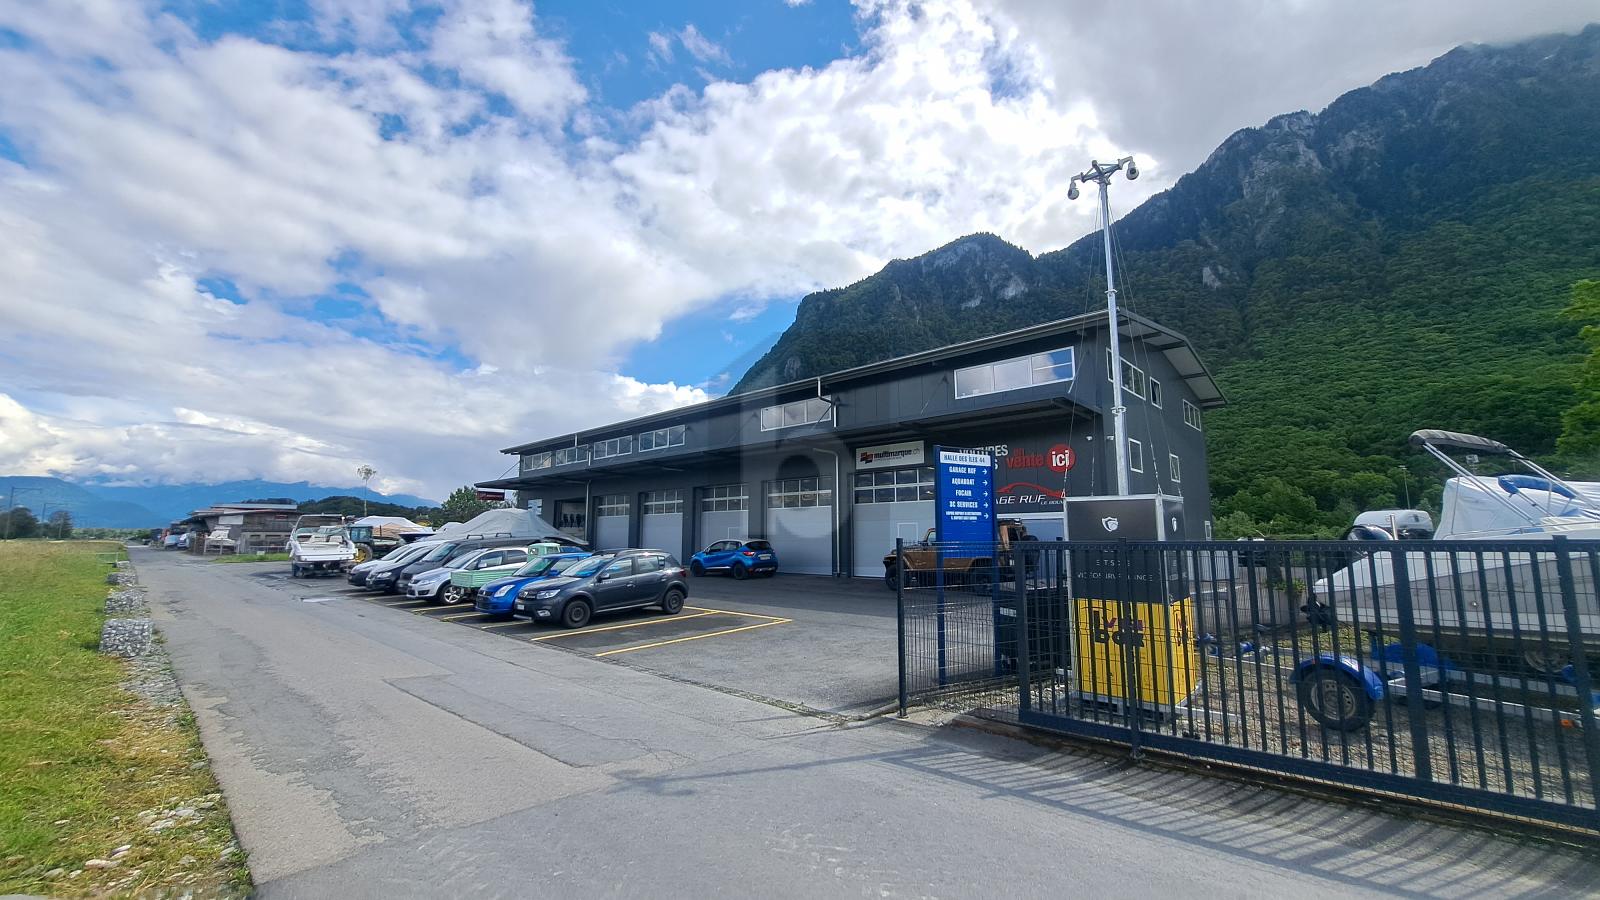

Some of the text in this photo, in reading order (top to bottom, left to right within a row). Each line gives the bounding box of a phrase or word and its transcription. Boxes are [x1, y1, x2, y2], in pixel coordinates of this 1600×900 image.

[874, 447, 920, 459] multimarque.ch
[1052, 449, 1070, 467] ici
[948, 466, 967, 474] GARAGE
[1019, 494, 1047, 504] RUF
